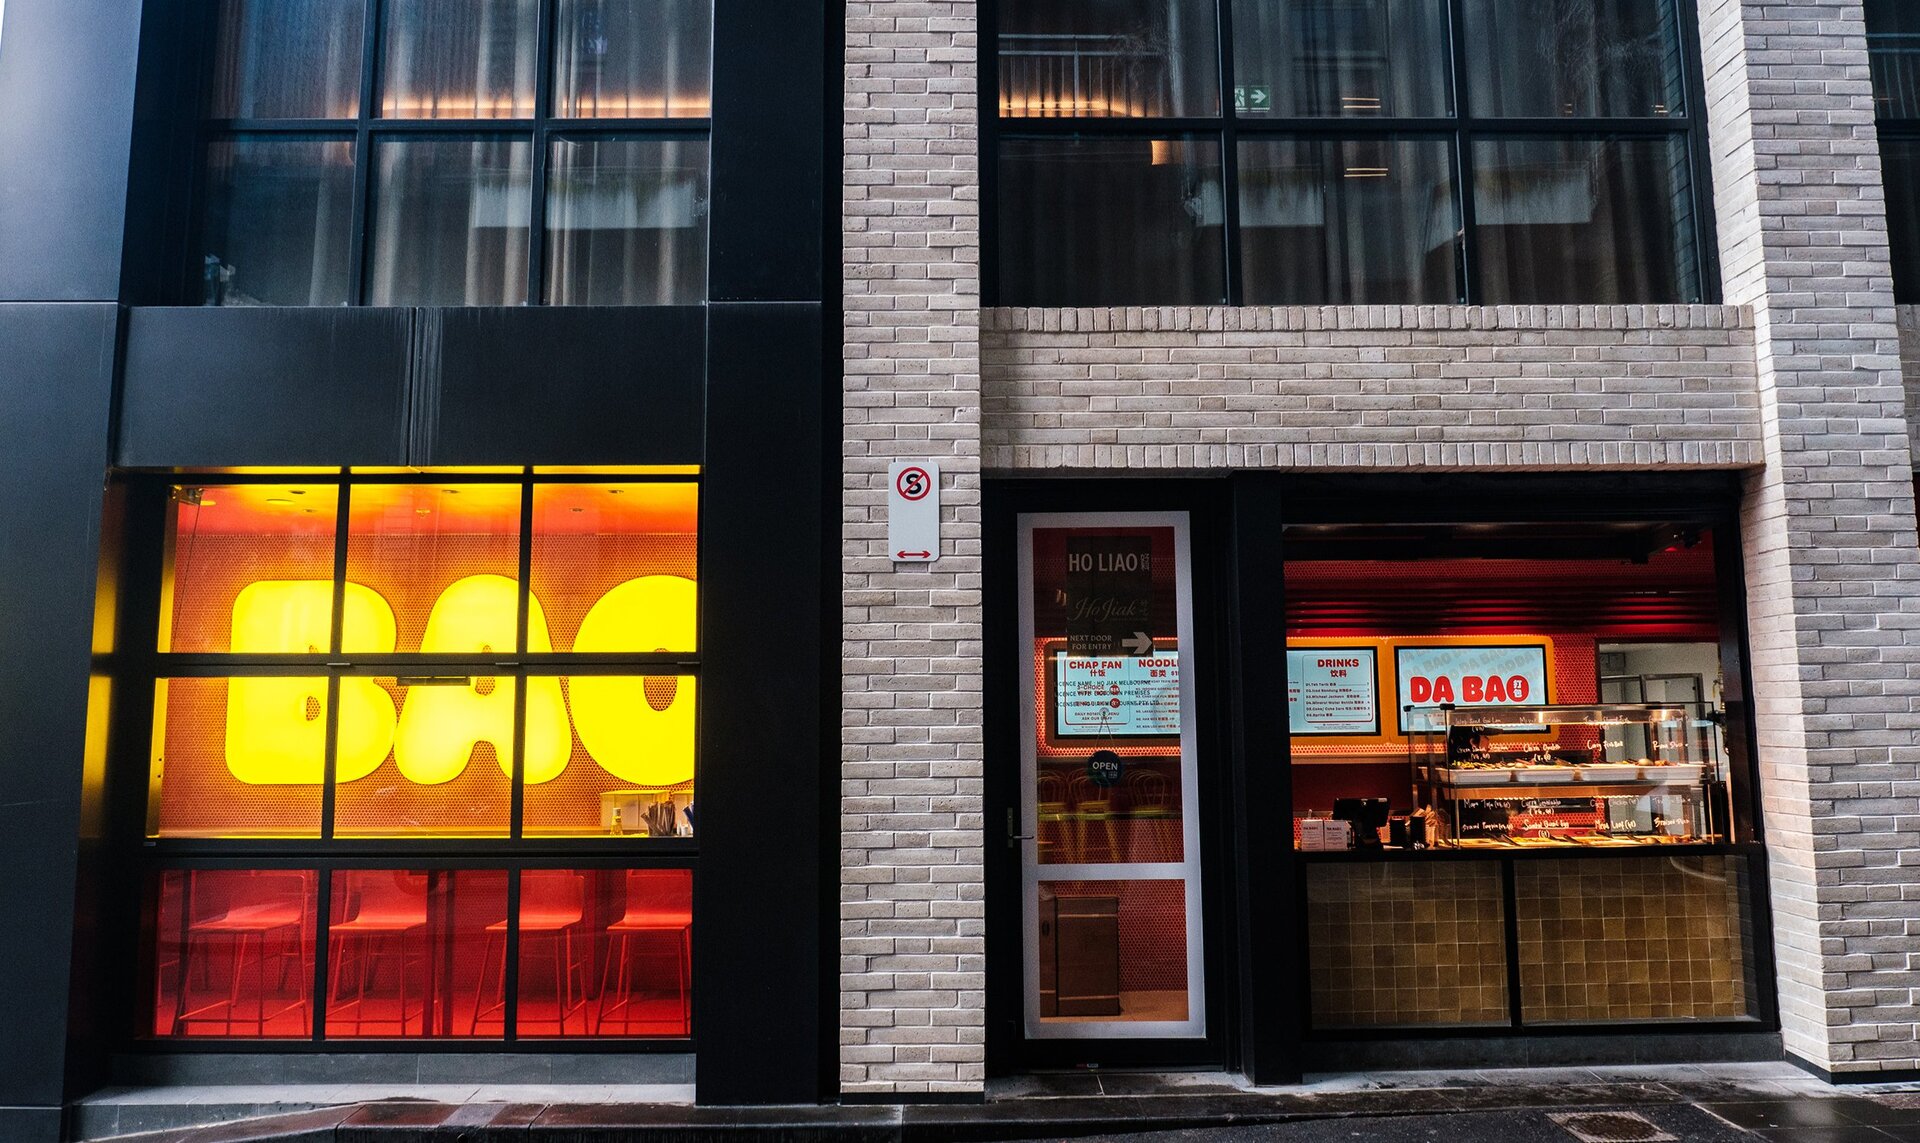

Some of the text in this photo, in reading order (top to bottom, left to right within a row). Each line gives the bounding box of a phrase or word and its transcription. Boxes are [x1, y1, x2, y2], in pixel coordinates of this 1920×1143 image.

[906, 473, 922, 495] S
[1068, 553, 1138, 572] HO LIAO
[1070, 634, 1113, 642] NEXT DOOR
[1072, 643, 1113, 651] FOR ENTRY
[1069, 660, 1122, 669] CHAP FAN
[1138, 658, 1179, 668] NOODL
[1317, 658, 1359, 667] DRINKS
[1330, 669, 1347, 677] 饮料
[1410, 675, 1530, 703] DA BAO
[1092, 761, 1119, 771] OPEN
